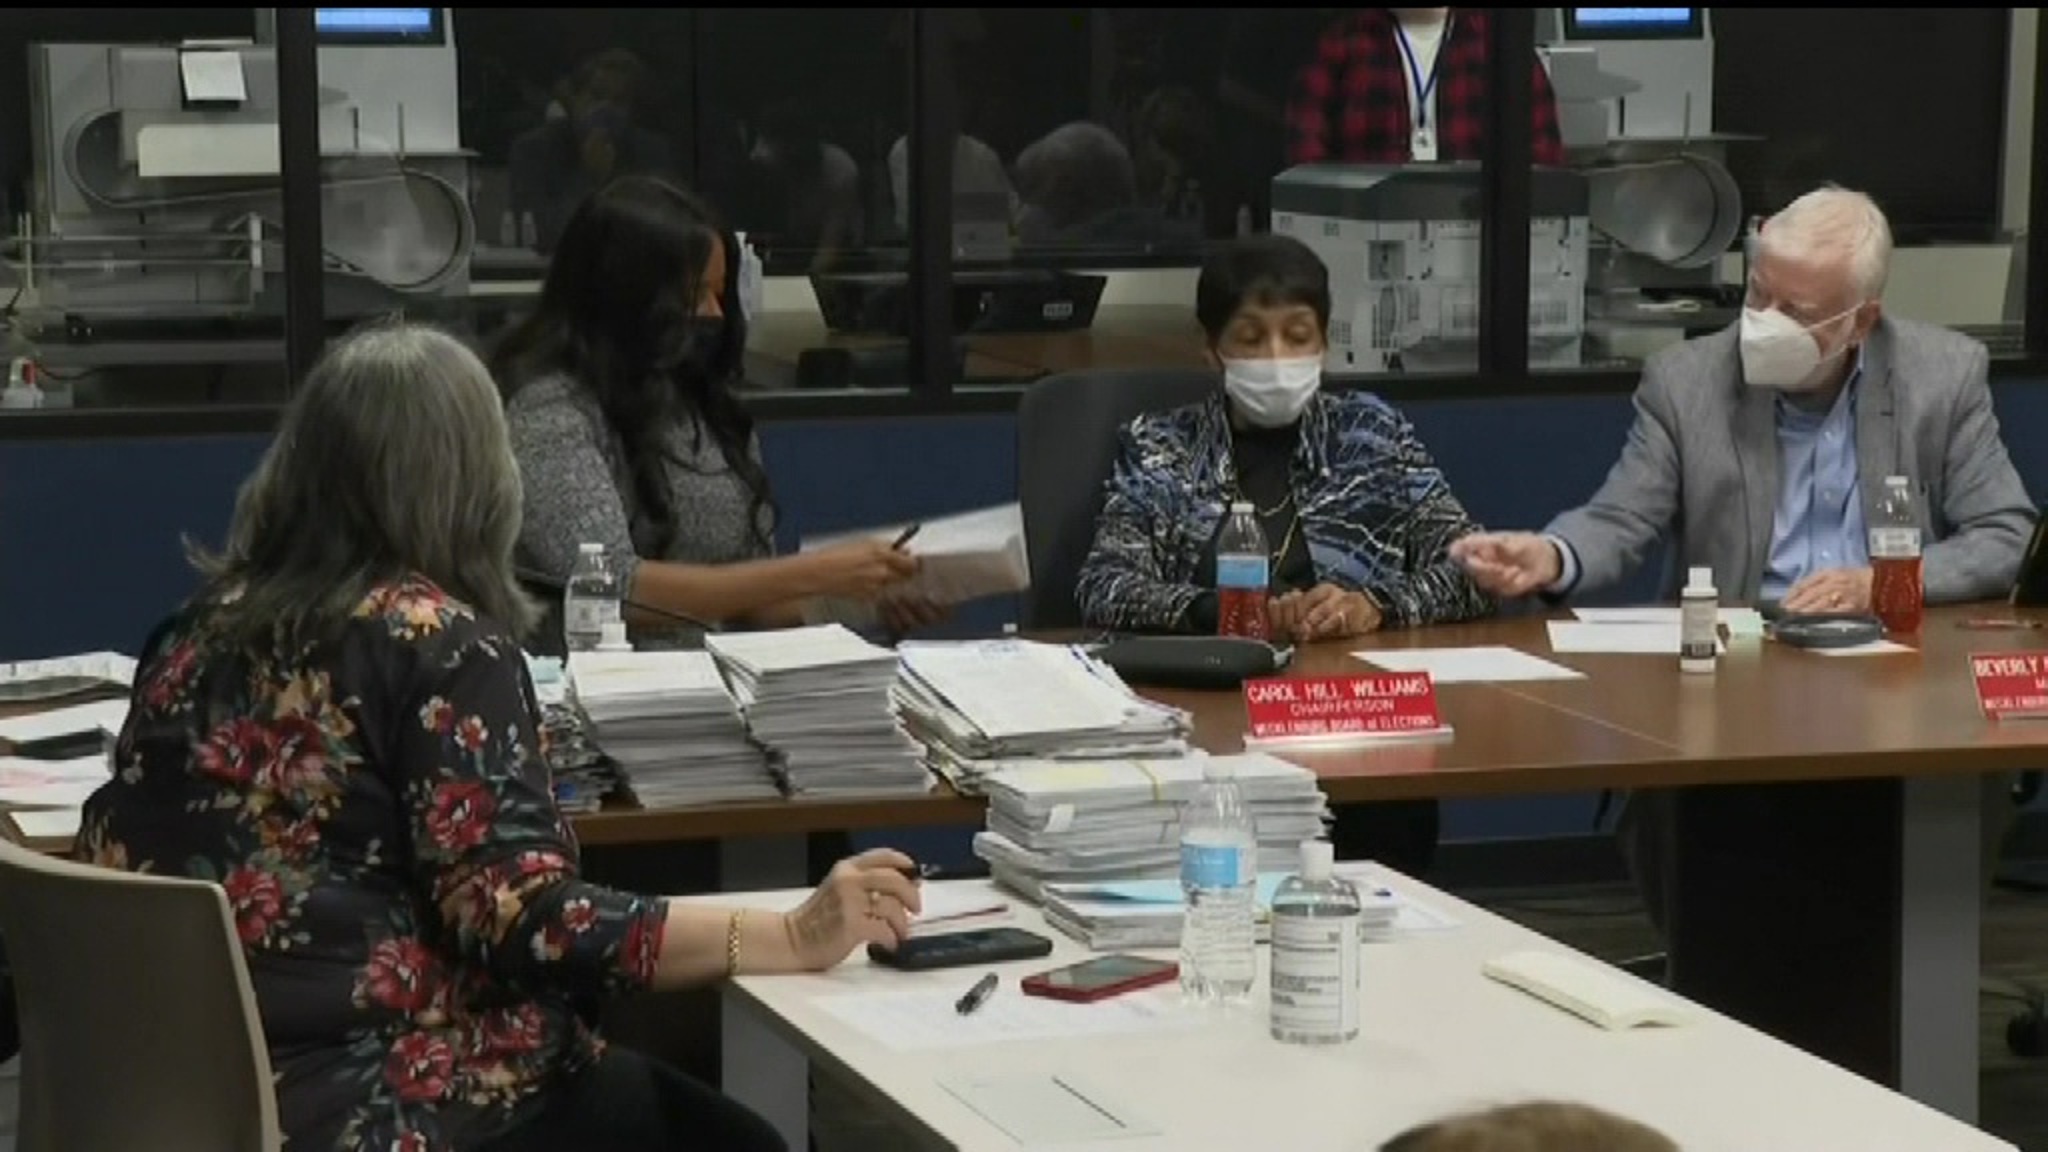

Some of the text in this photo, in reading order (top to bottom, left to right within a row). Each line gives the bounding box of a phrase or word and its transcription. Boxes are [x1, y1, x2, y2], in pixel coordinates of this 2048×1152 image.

[1974, 655, 2037, 677] BEVERLY
[1247, 677, 1429, 704] CAROL HILL WILLIAMS
[1290, 699, 1395, 717] CHAIRPERSON
[1379, 715, 1436, 729] ELECTIONS
